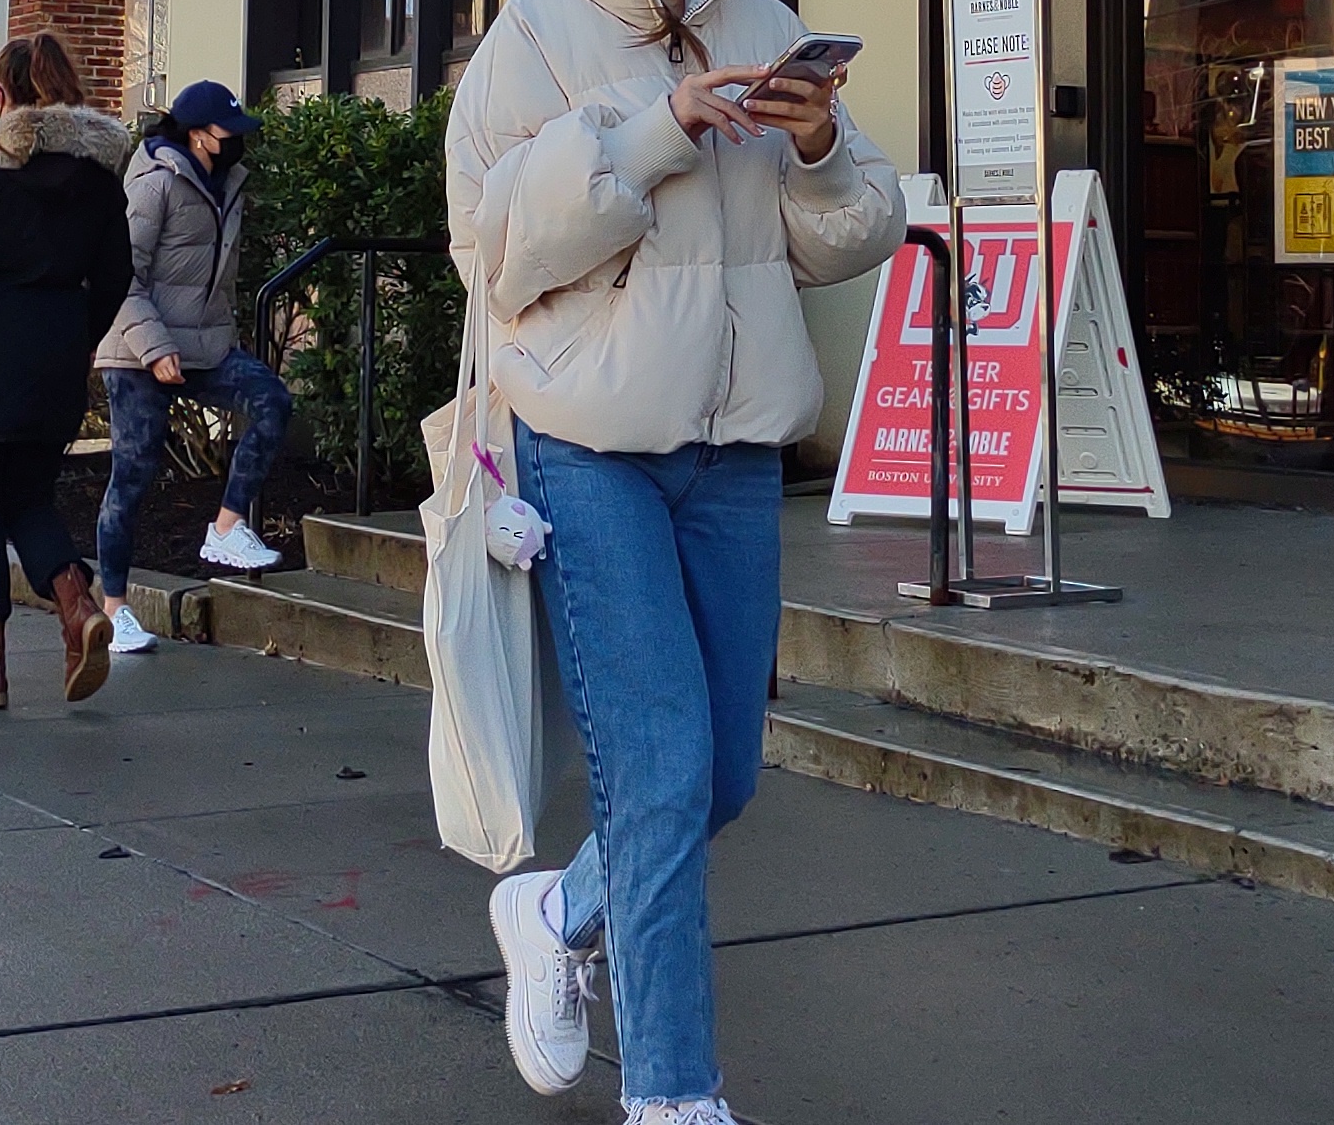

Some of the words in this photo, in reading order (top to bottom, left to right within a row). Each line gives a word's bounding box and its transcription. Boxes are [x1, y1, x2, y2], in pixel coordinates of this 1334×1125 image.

[964, 37, 999, 56] PLEASE
[1294, 96, 1328, 121] NEW
[1295, 126, 1331, 151] BEST
[912, 360, 1000, 383] TEIER
[876, 387, 933, 409] GEAR
[968, 388, 1030, 411] GIFTS
[867, 470, 919, 484] BOSTON
[923, 473, 1003, 487] UVSITY
